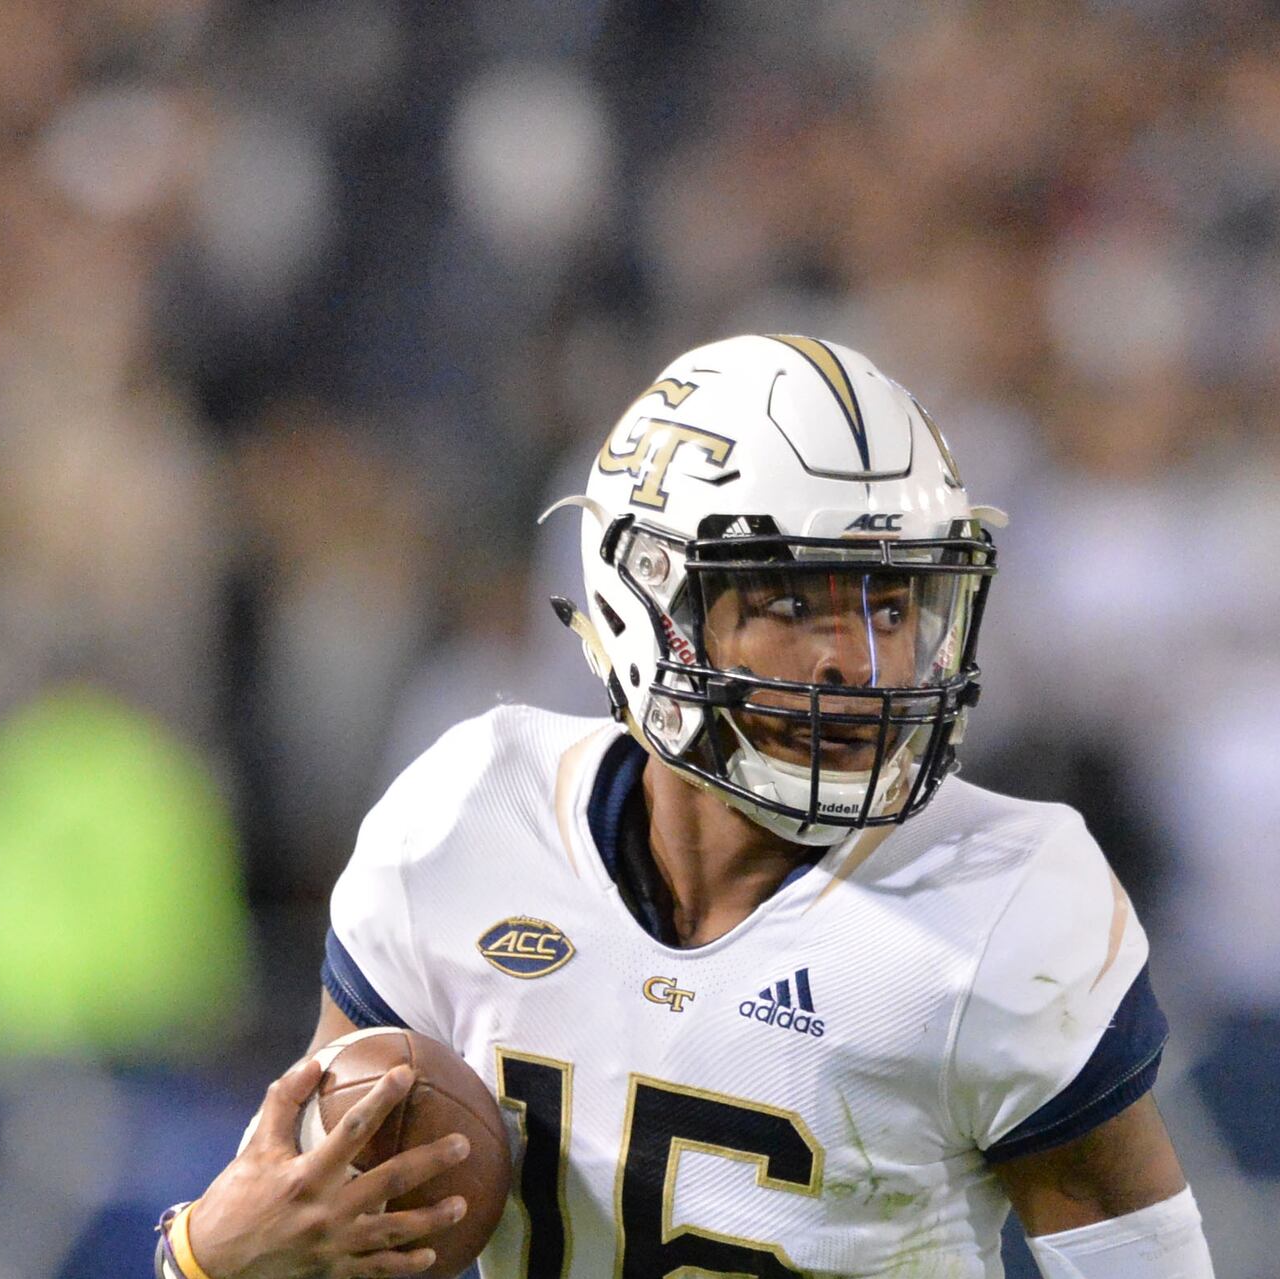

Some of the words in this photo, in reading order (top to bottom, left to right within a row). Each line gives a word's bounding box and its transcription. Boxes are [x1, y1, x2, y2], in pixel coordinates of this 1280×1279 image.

[844, 513, 904, 531] ACC
[487, 930, 562, 954] ACC
[642, 975, 696, 1013] GT
[739, 1000, 825, 1038] adidas
